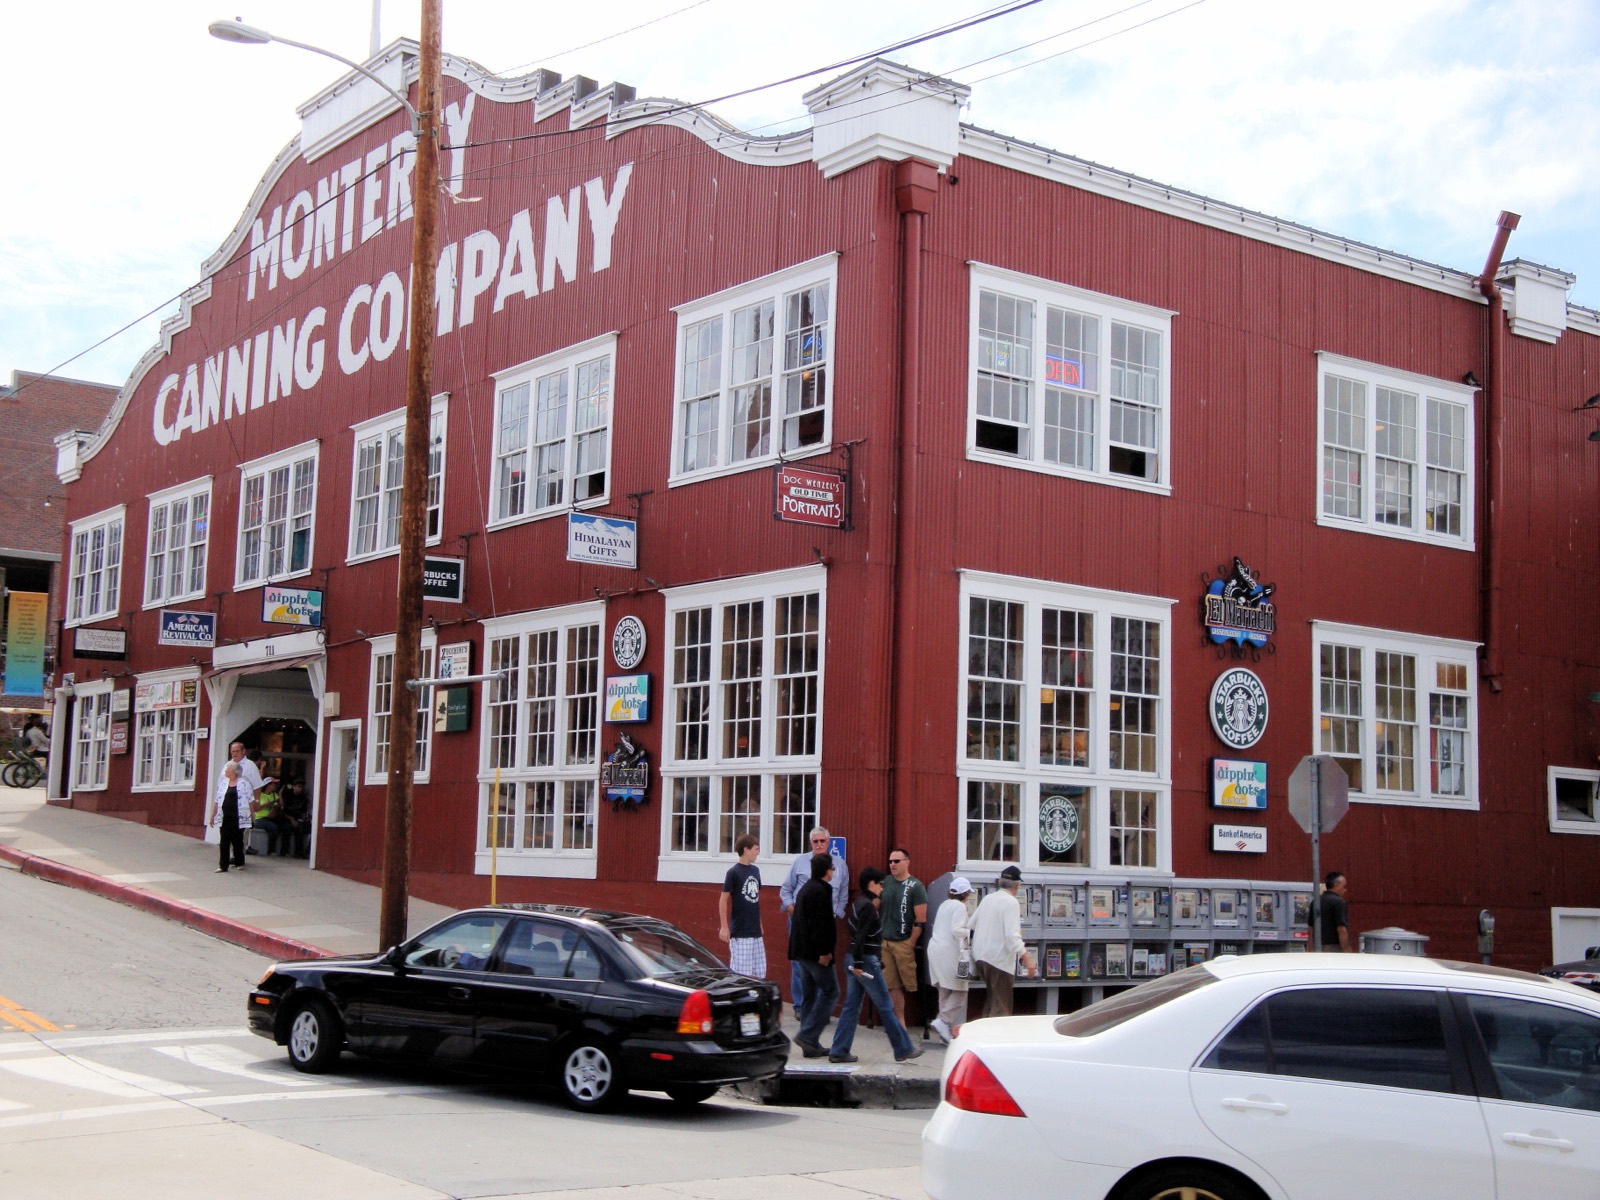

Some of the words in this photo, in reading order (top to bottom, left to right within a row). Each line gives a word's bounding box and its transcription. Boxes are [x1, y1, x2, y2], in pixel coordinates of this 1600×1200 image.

[246, 91, 476, 301] MONTERY
[152, 306, 328, 446] CANNING
[338, 161, 635, 375] COMPANY
[1044, 357, 1081, 385] OPEN
[783, 475, 802, 484] DOC
[794, 488, 809, 497] OLD
[811, 490, 829, 499] TIME
[782, 494, 841, 519] PORTRAITS
[574, 531, 632, 549] HIMALAYAN
[588, 544, 618, 557] GIFTS
[424, 570, 457, 581] RBUCKS
[424, 578, 448, 587] OFFEE
[269, 592, 312, 606] dippin'
[286, 603, 315, 617] dots
[167, 621, 210, 633] AMERICAN
[615, 619, 641, 642] STARBUCKS
[163, 630, 198, 640] REVIVAL
[265, 645, 275, 657] 711
[617, 653, 638, 667] COFFEE
[1216, 672, 1265, 706] STARBUCKS
[621, 697, 642, 710] dots
[1222, 724, 1260, 745] COFFEE
[1218, 767, 1258, 783] dippin'
[1234, 783, 1261, 796] dots
[1040, 798, 1077, 823] STARBUCKS
[1218, 829, 1233, 838] Bank
[1233, 829, 1240, 838] of
[1239, 830, 1262, 840] America
[1043, 835, 1072, 850] COFFEE
